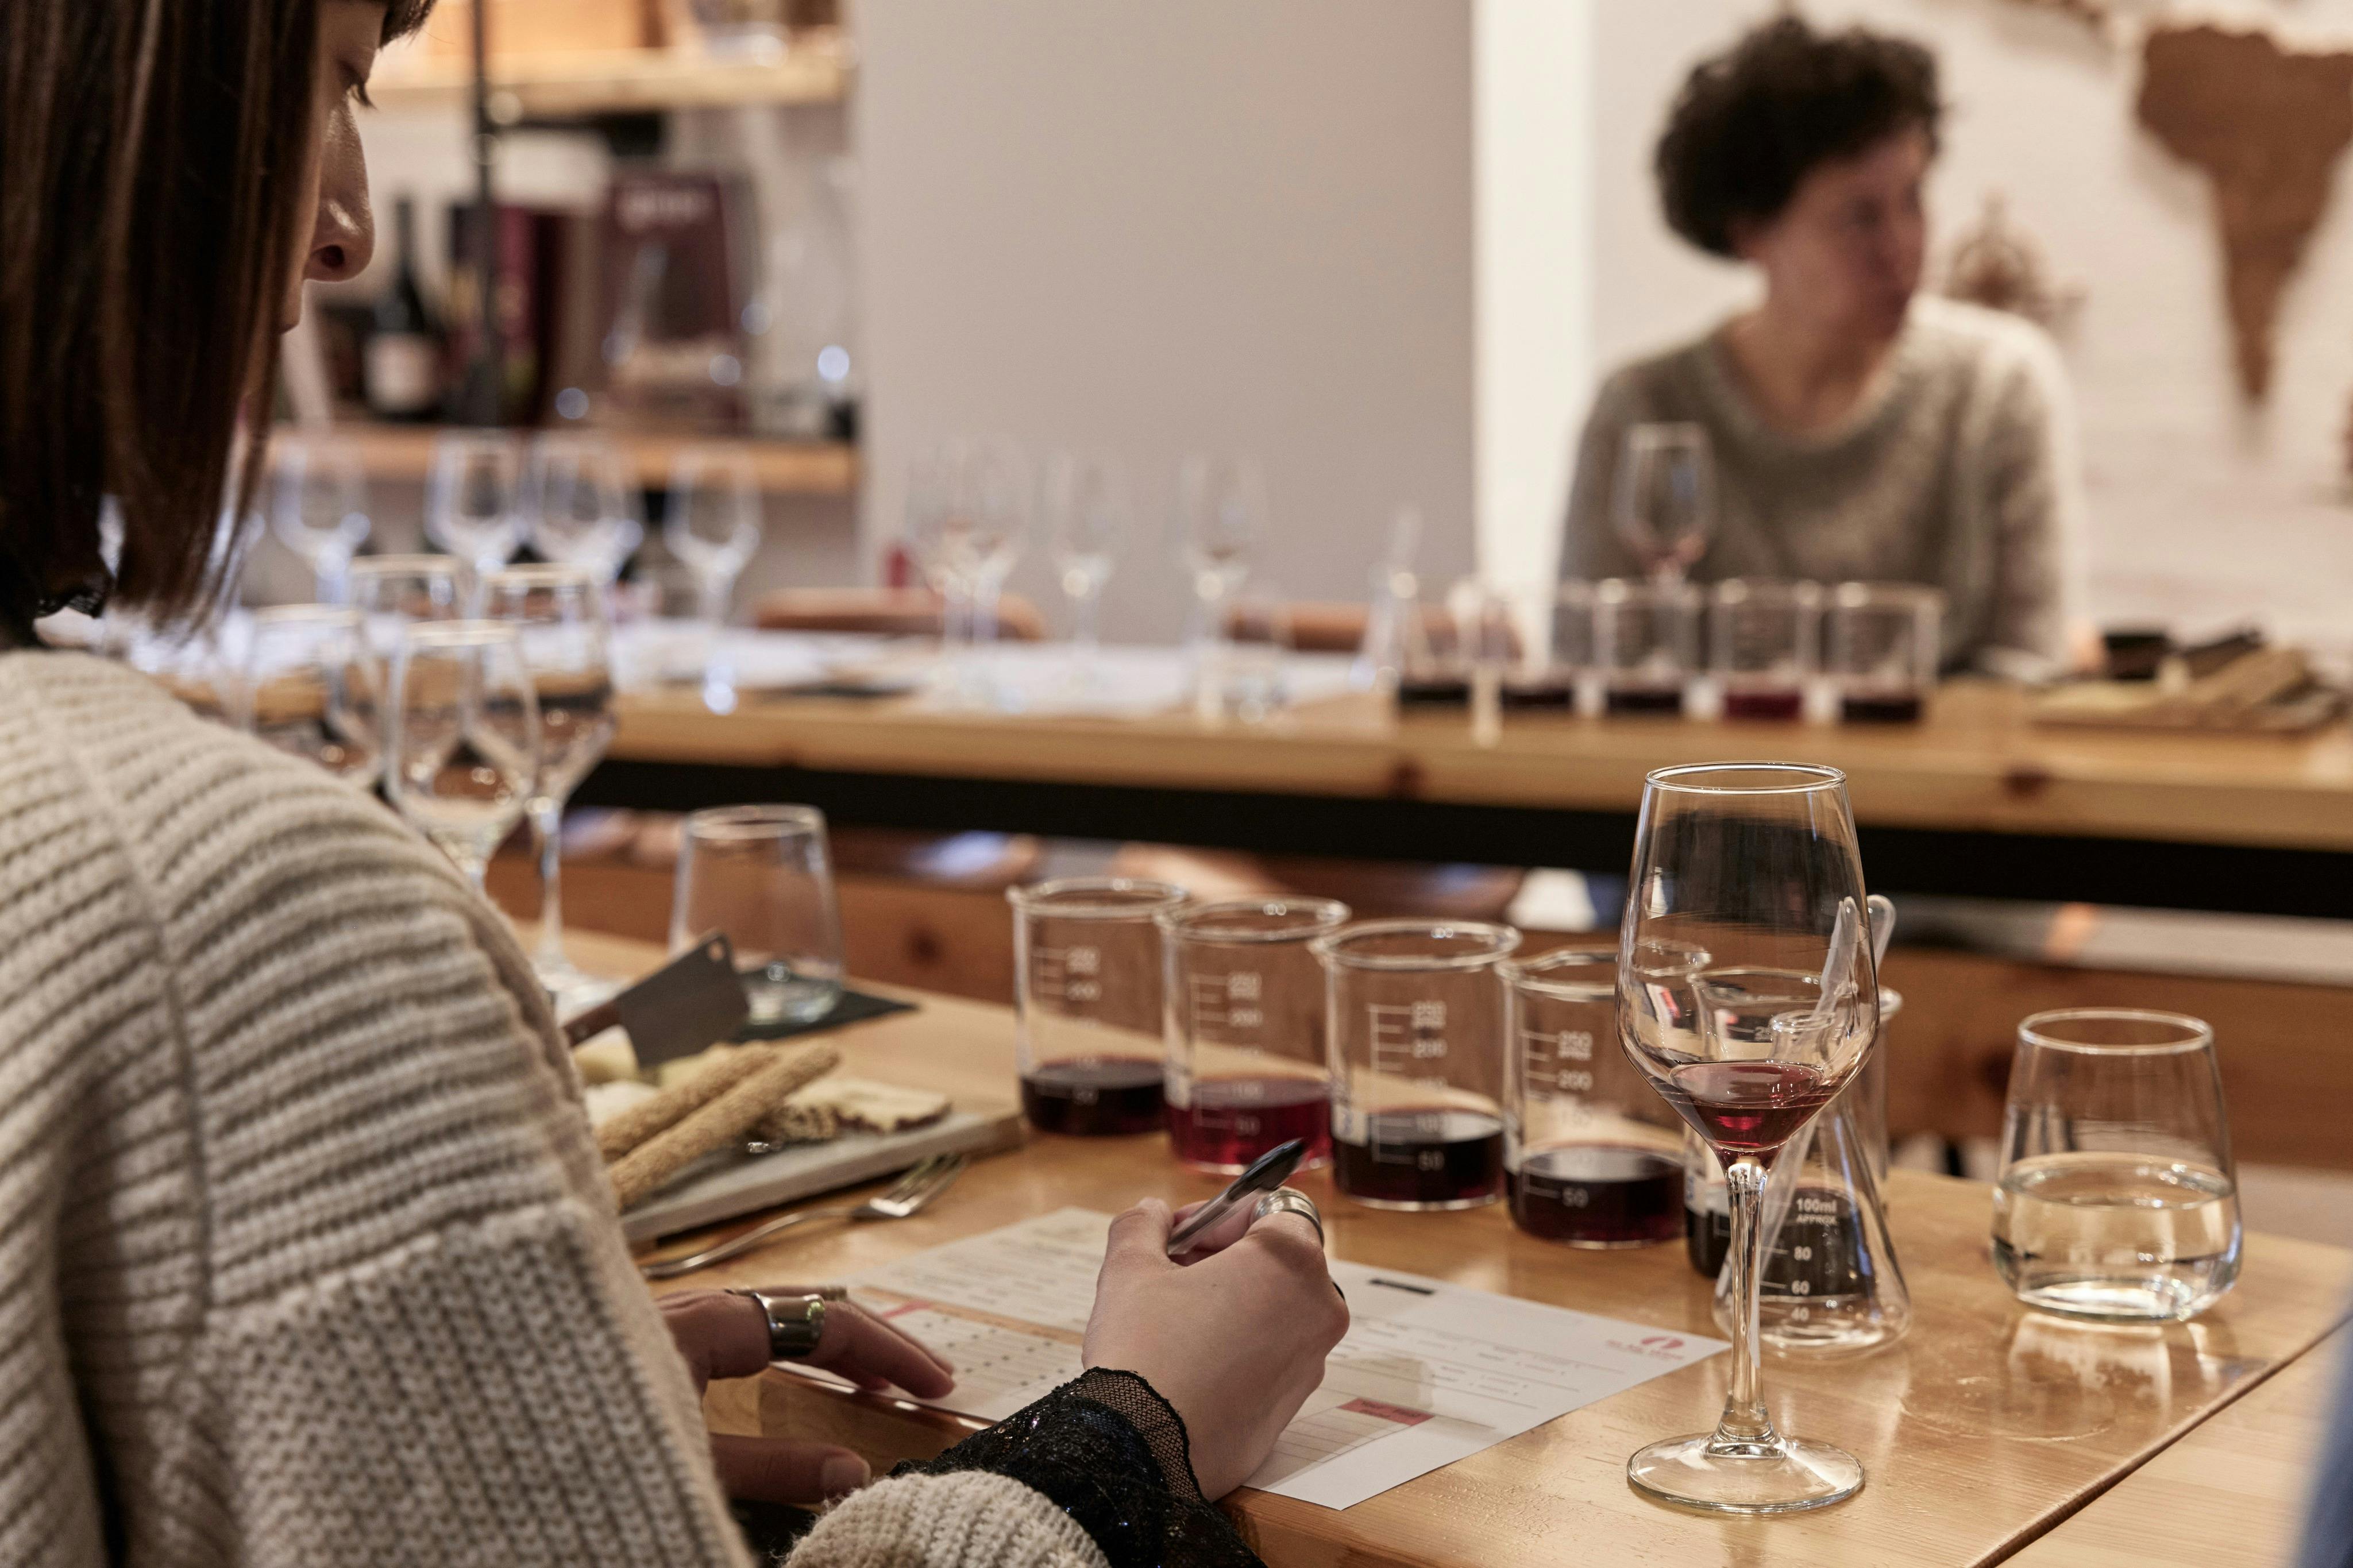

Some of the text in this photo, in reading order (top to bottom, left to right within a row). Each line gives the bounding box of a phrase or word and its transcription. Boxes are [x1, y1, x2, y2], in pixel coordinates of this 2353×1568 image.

[1558, 1069, 1594, 1091] 200
[1561, 1185, 1590, 1208] 50
[1796, 1198, 1837, 1213] 100ml
[1793, 1245, 1812, 1261] 80
[1791, 1280, 1810, 1296] 60
[1791, 1306, 1810, 1321] 40
